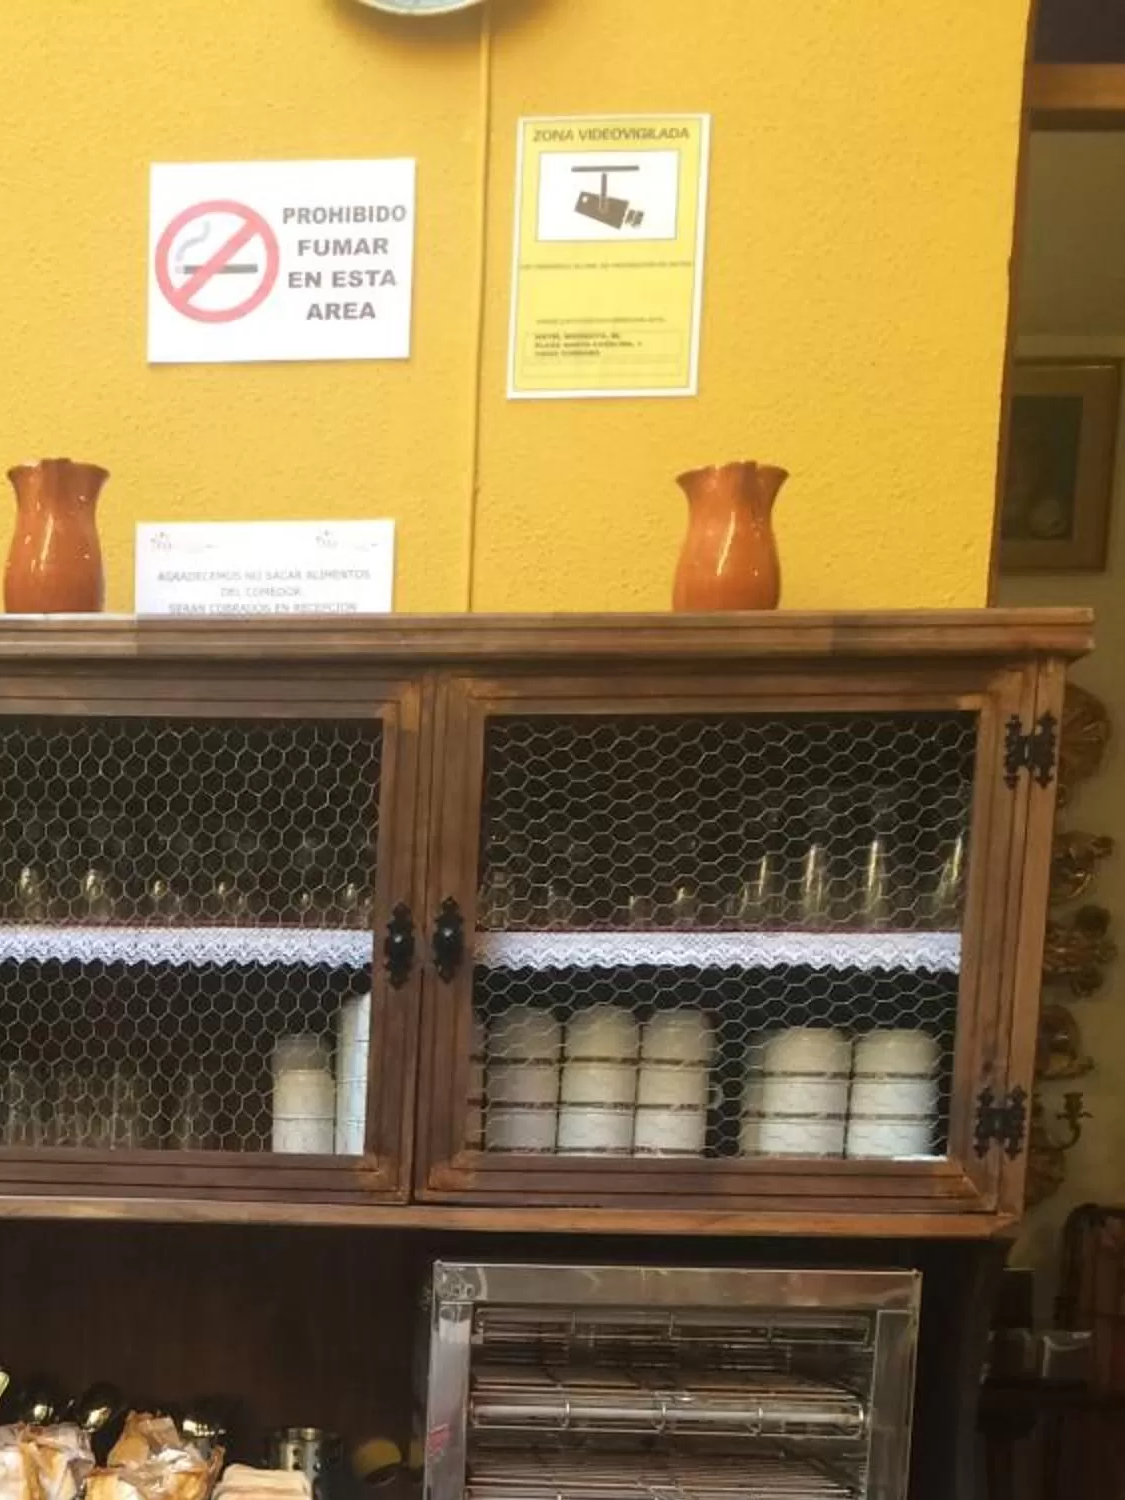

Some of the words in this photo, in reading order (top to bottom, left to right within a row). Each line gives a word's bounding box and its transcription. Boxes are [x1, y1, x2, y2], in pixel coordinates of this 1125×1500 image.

[533, 129, 574, 143] ZONA
[578, 127, 690, 142] VIDEOVIGILADA
[282, 205, 407, 225] PROHIBIDO
[297, 238, 389, 256] FUMAR
[288, 271, 322, 289] EN
[332, 270, 397, 288] ESTA
[306, 302, 377, 321] AREA
[306, 568, 372, 581] ALIMENTOS
